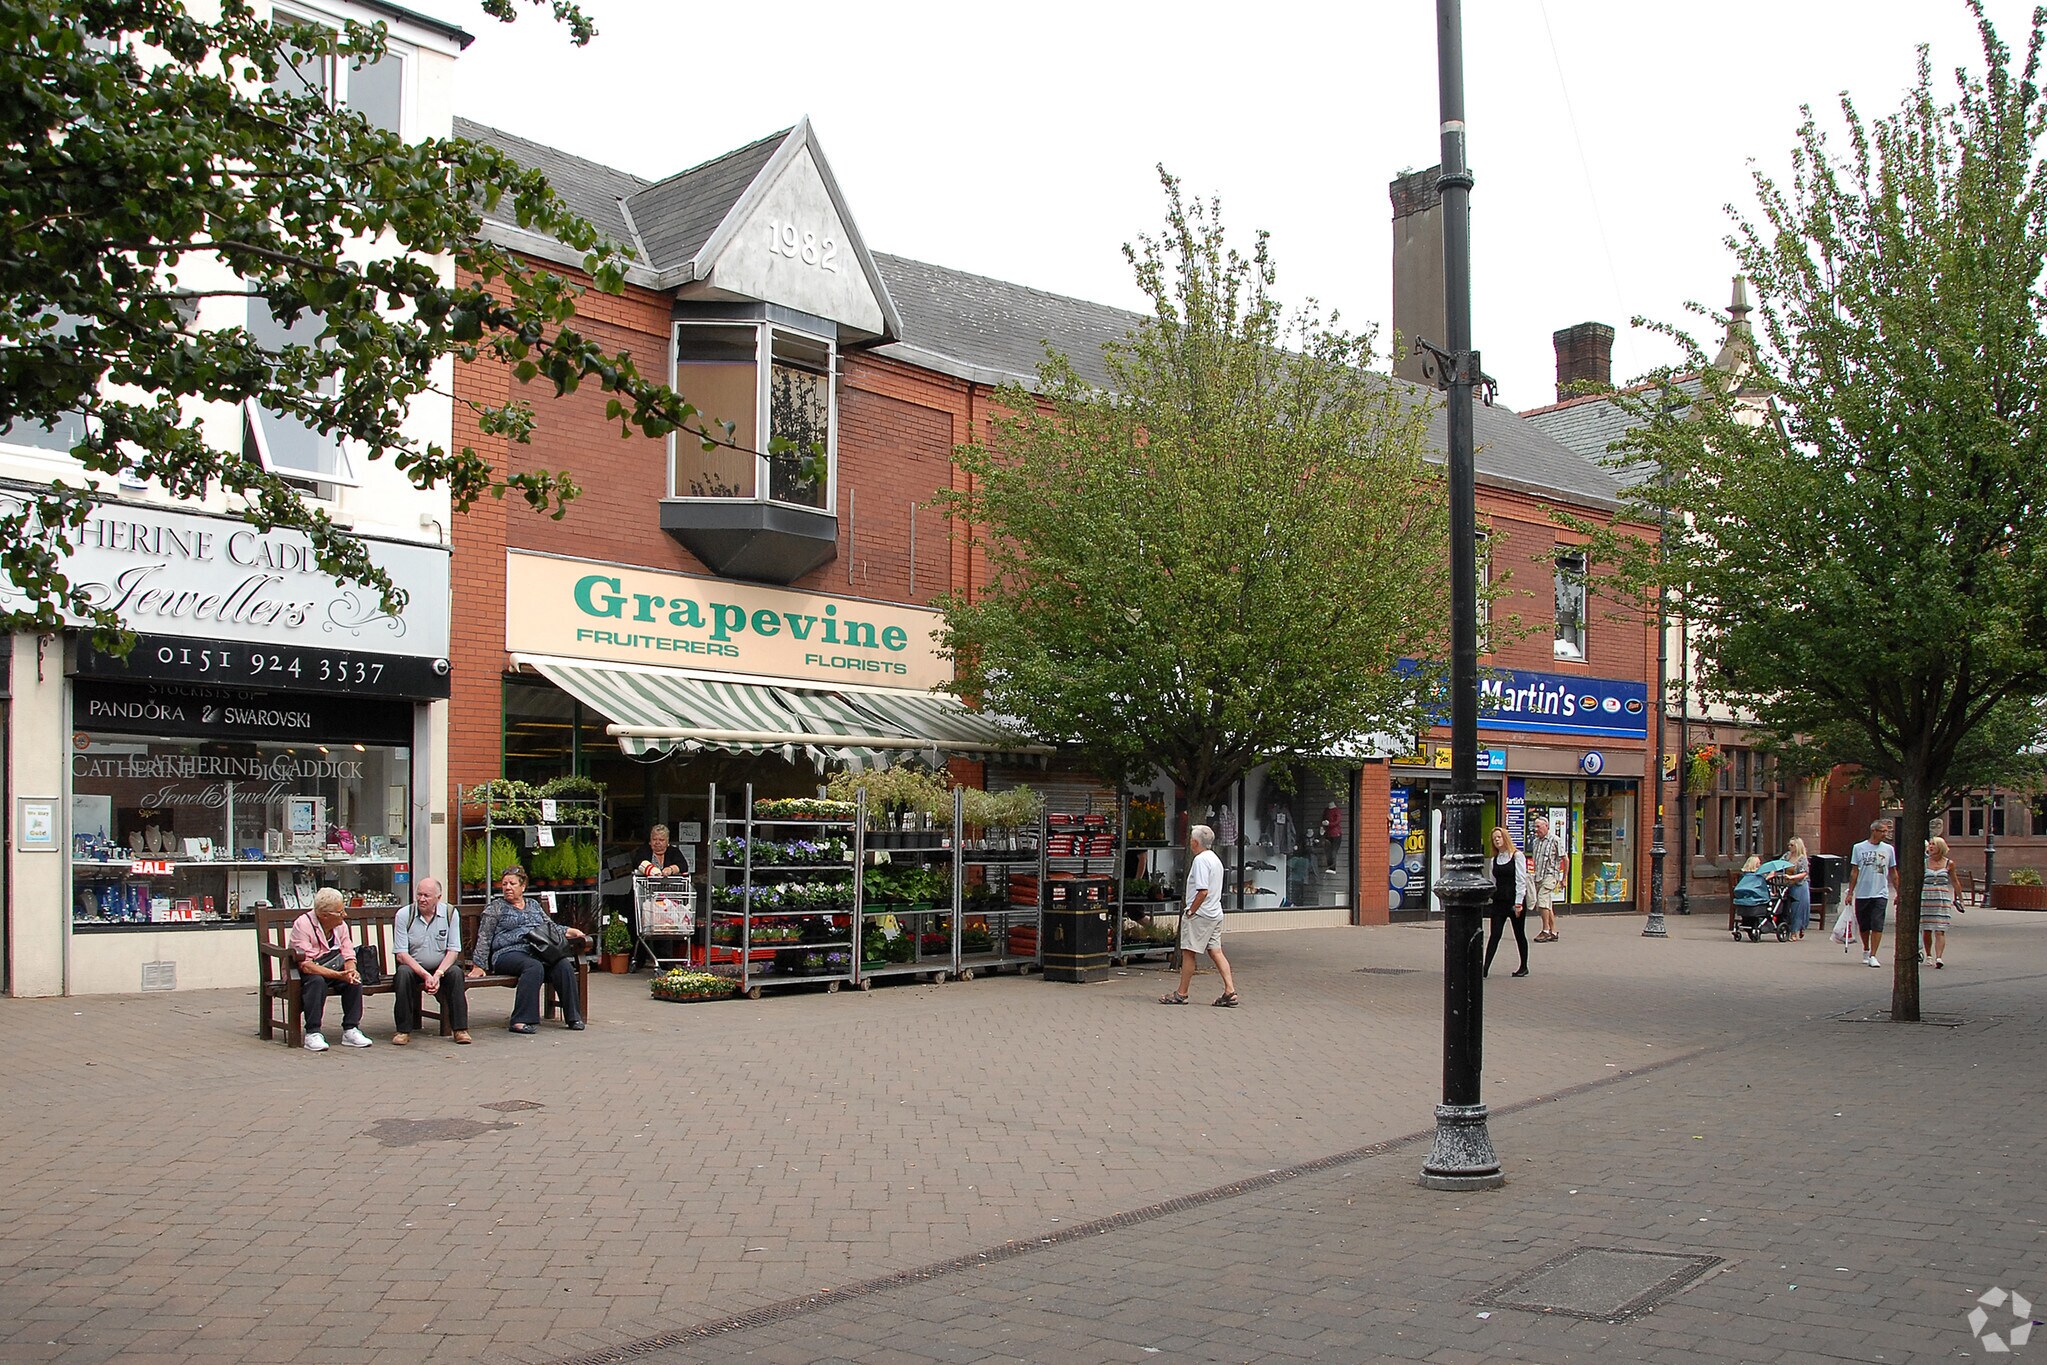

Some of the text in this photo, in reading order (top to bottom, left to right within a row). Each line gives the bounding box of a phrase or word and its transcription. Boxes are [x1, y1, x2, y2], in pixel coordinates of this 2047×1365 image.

[768, 219, 838, 273] 1982
[65, 563, 314, 628] Jewellers
[573, 575, 908, 651] Grapevine
[157, 647, 384, 683] 0151 924 3537
[577, 629, 907, 675] FRUITERERS FLORISTS
[89, 698, 311, 728] PANDORA SWAROVSKI
[1479, 680, 1576, 717] Martin's
[129, 752, 364, 779] CATHERINE CADDICK
[131, 860, 175, 875] SALE
[161, 909, 201, 922] SALE
